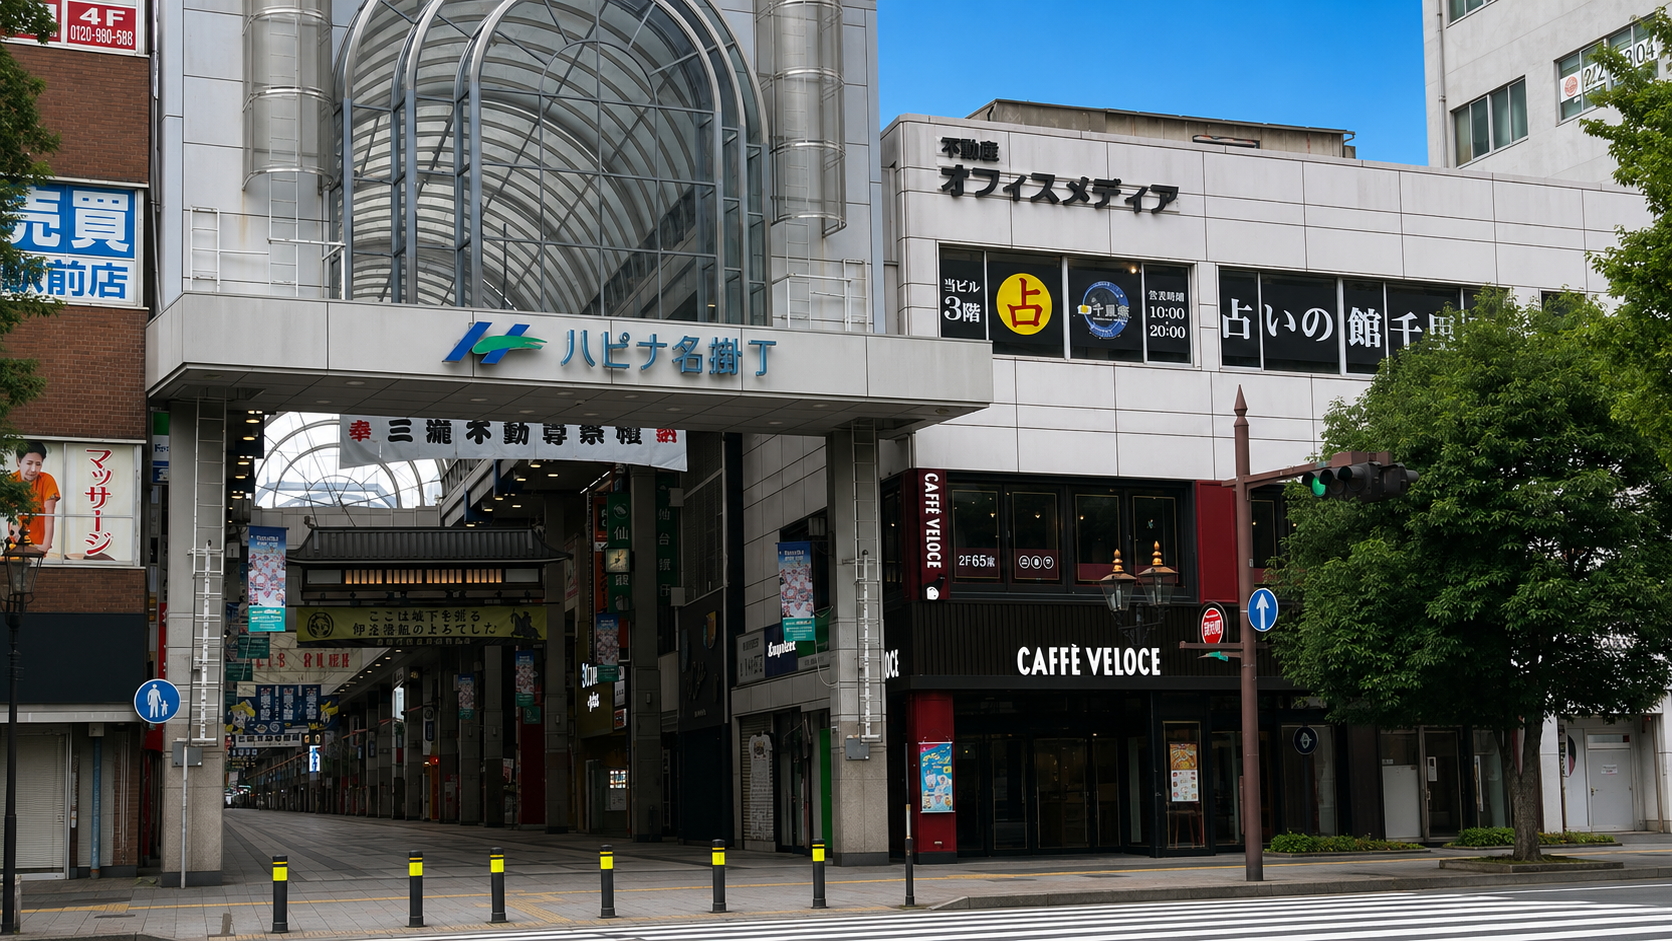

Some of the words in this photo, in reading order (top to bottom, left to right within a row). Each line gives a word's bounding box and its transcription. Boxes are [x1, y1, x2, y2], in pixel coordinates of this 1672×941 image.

[79, 7, 126, 27] 4F
[70, 24, 133, 46] 0120-980-588
[941, 137, 999, 162] 不動産
[941, 164, 1179, 214] オフィスメディア
[8, 186, 130, 252] 売買
[944, 278, 981, 293] 当ビル
[944, 295, 981, 323] 3階
[1007, 277, 1044, 328] 占
[1149, 306, 1185, 320] 10:00
[1149, 324, 1186, 339] 20:00
[560, 329, 777, 377] ハピナ名掛丁
[85, 449, 113, 555] マッサージ
[925, 518, 942, 569] VELOCE
[1017, 643, 1081, 676] CAFFÈ
[1085, 647, 1161, 676] VELOCE
